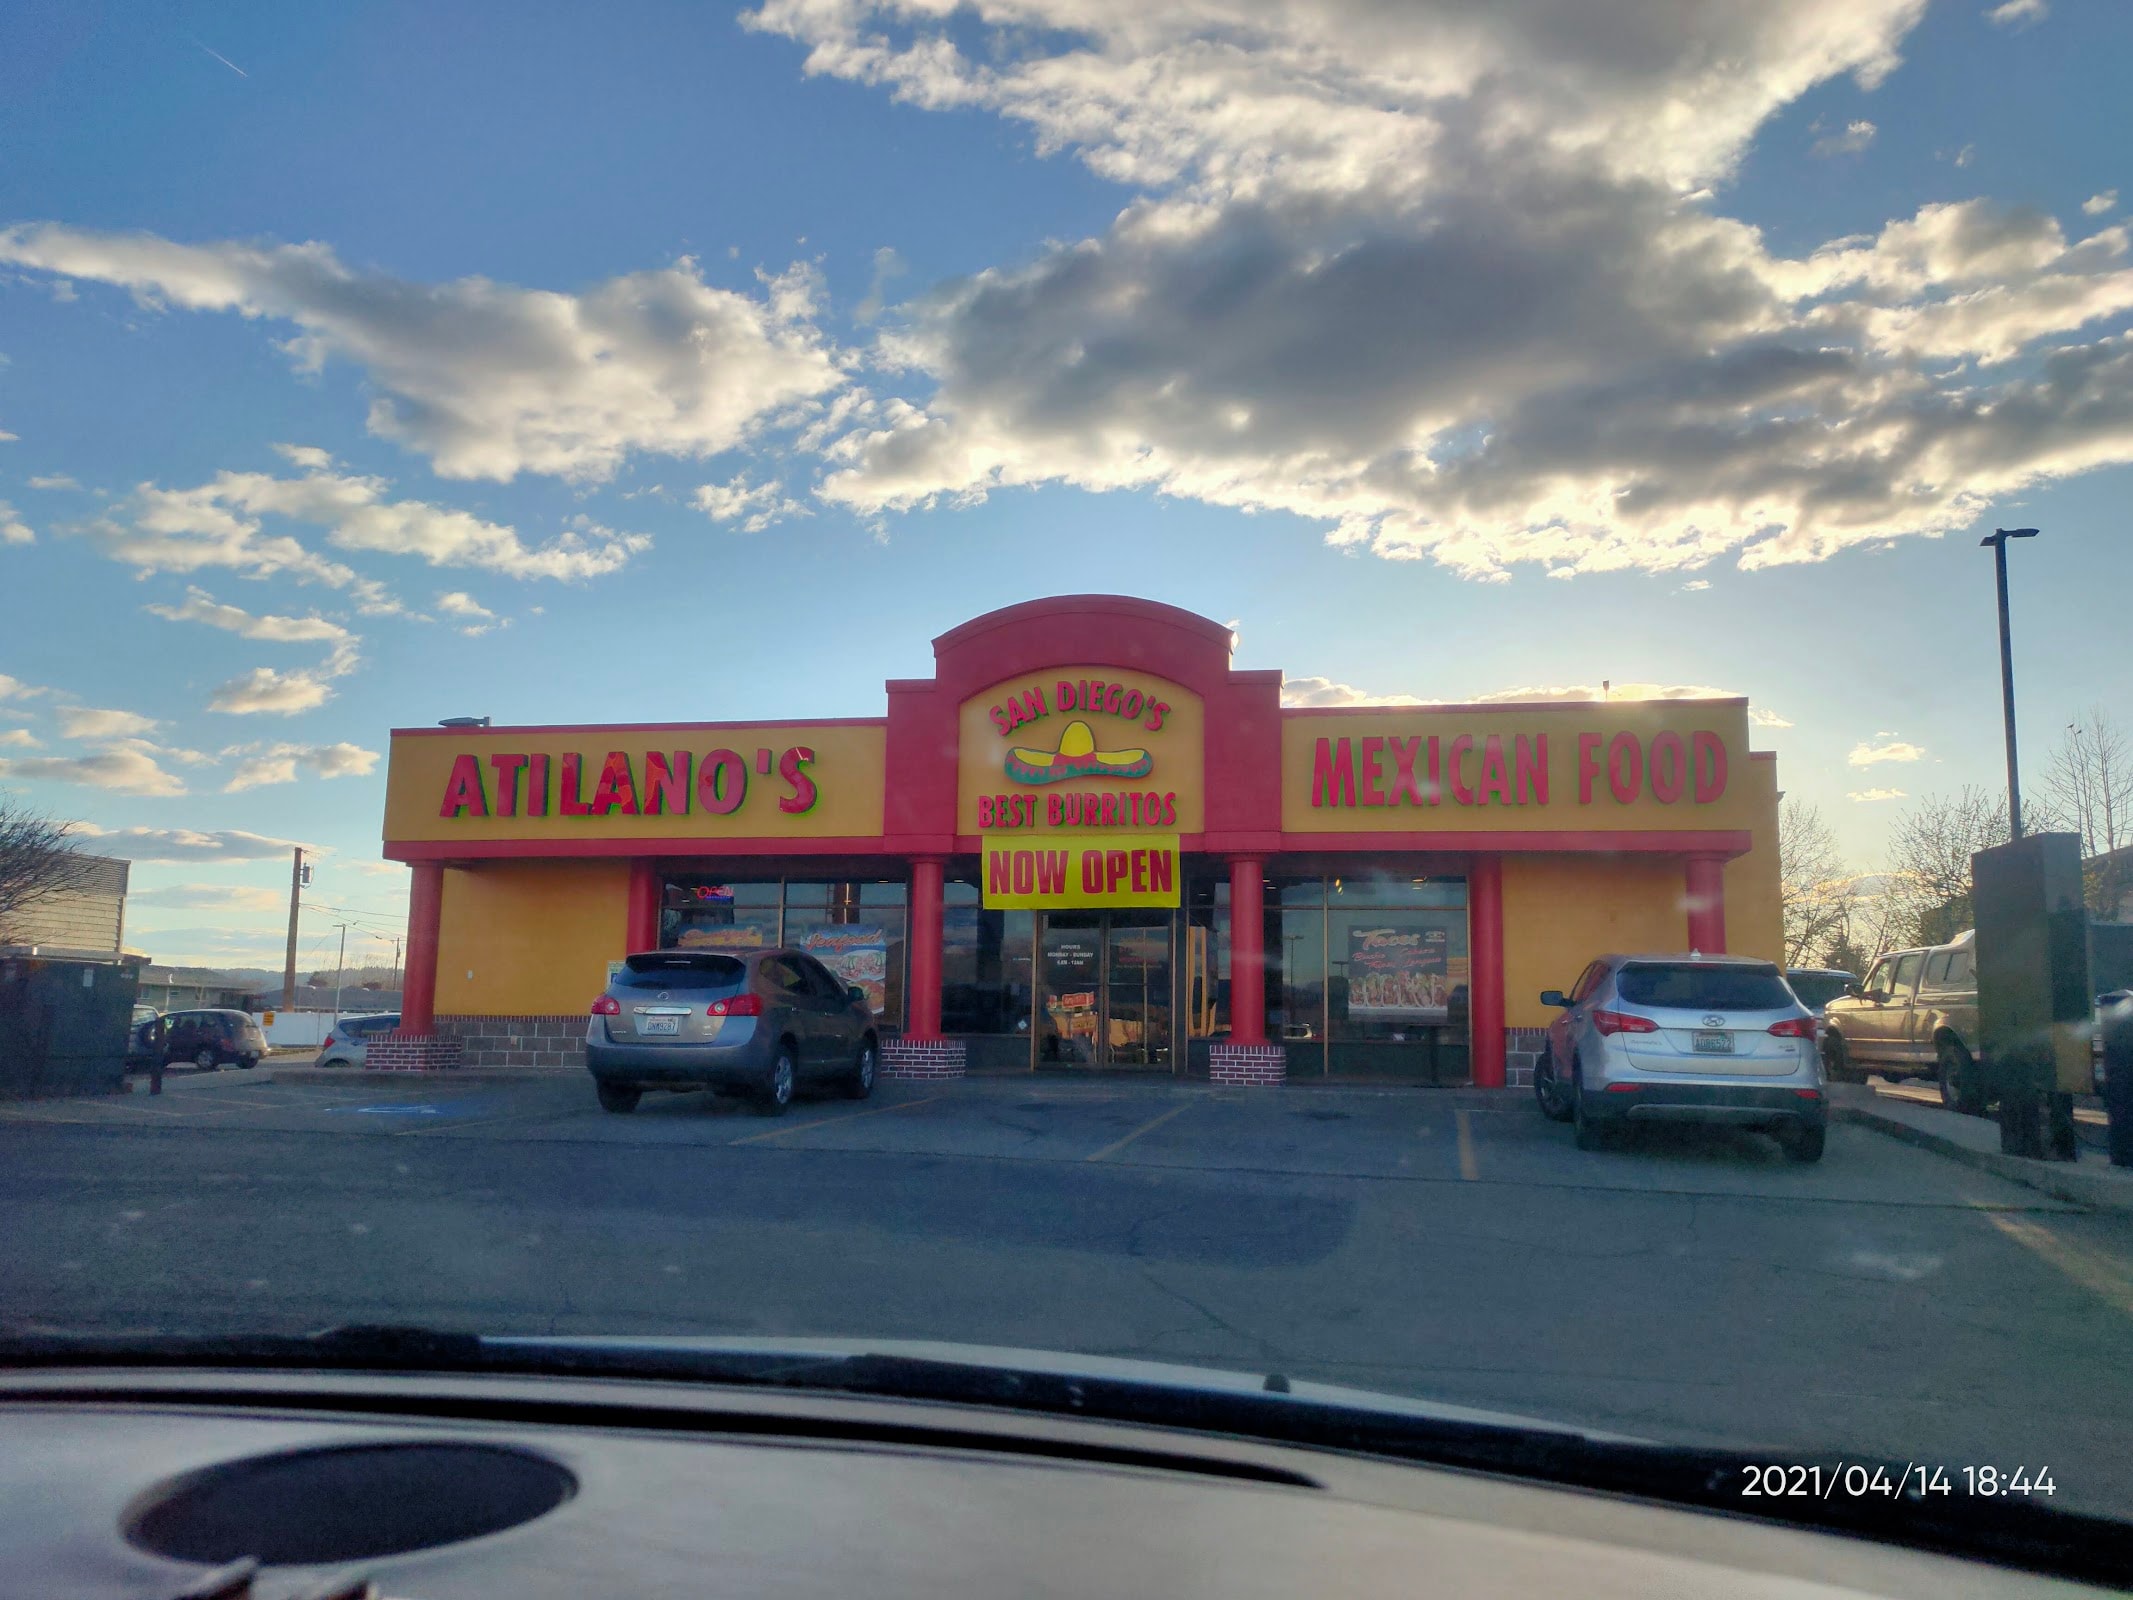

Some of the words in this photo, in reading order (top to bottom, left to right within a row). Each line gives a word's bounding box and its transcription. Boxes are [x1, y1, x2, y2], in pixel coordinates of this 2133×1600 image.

[989, 686, 1049, 736] SAN
[1056, 680, 1171, 731] DIEGO'S
[439, 746, 817, 818] ATILANO'S
[1311, 733, 1550, 807] MEXICAN
[1578, 730, 1728, 805] FOOD
[978, 794, 1037, 828] BEST
[1047, 792, 1176, 827] BURRITOS
[696, 886, 734, 900] OPEN
[989, 850, 1069, 896] NOW
[1081, 849, 1173, 894] OPEN
